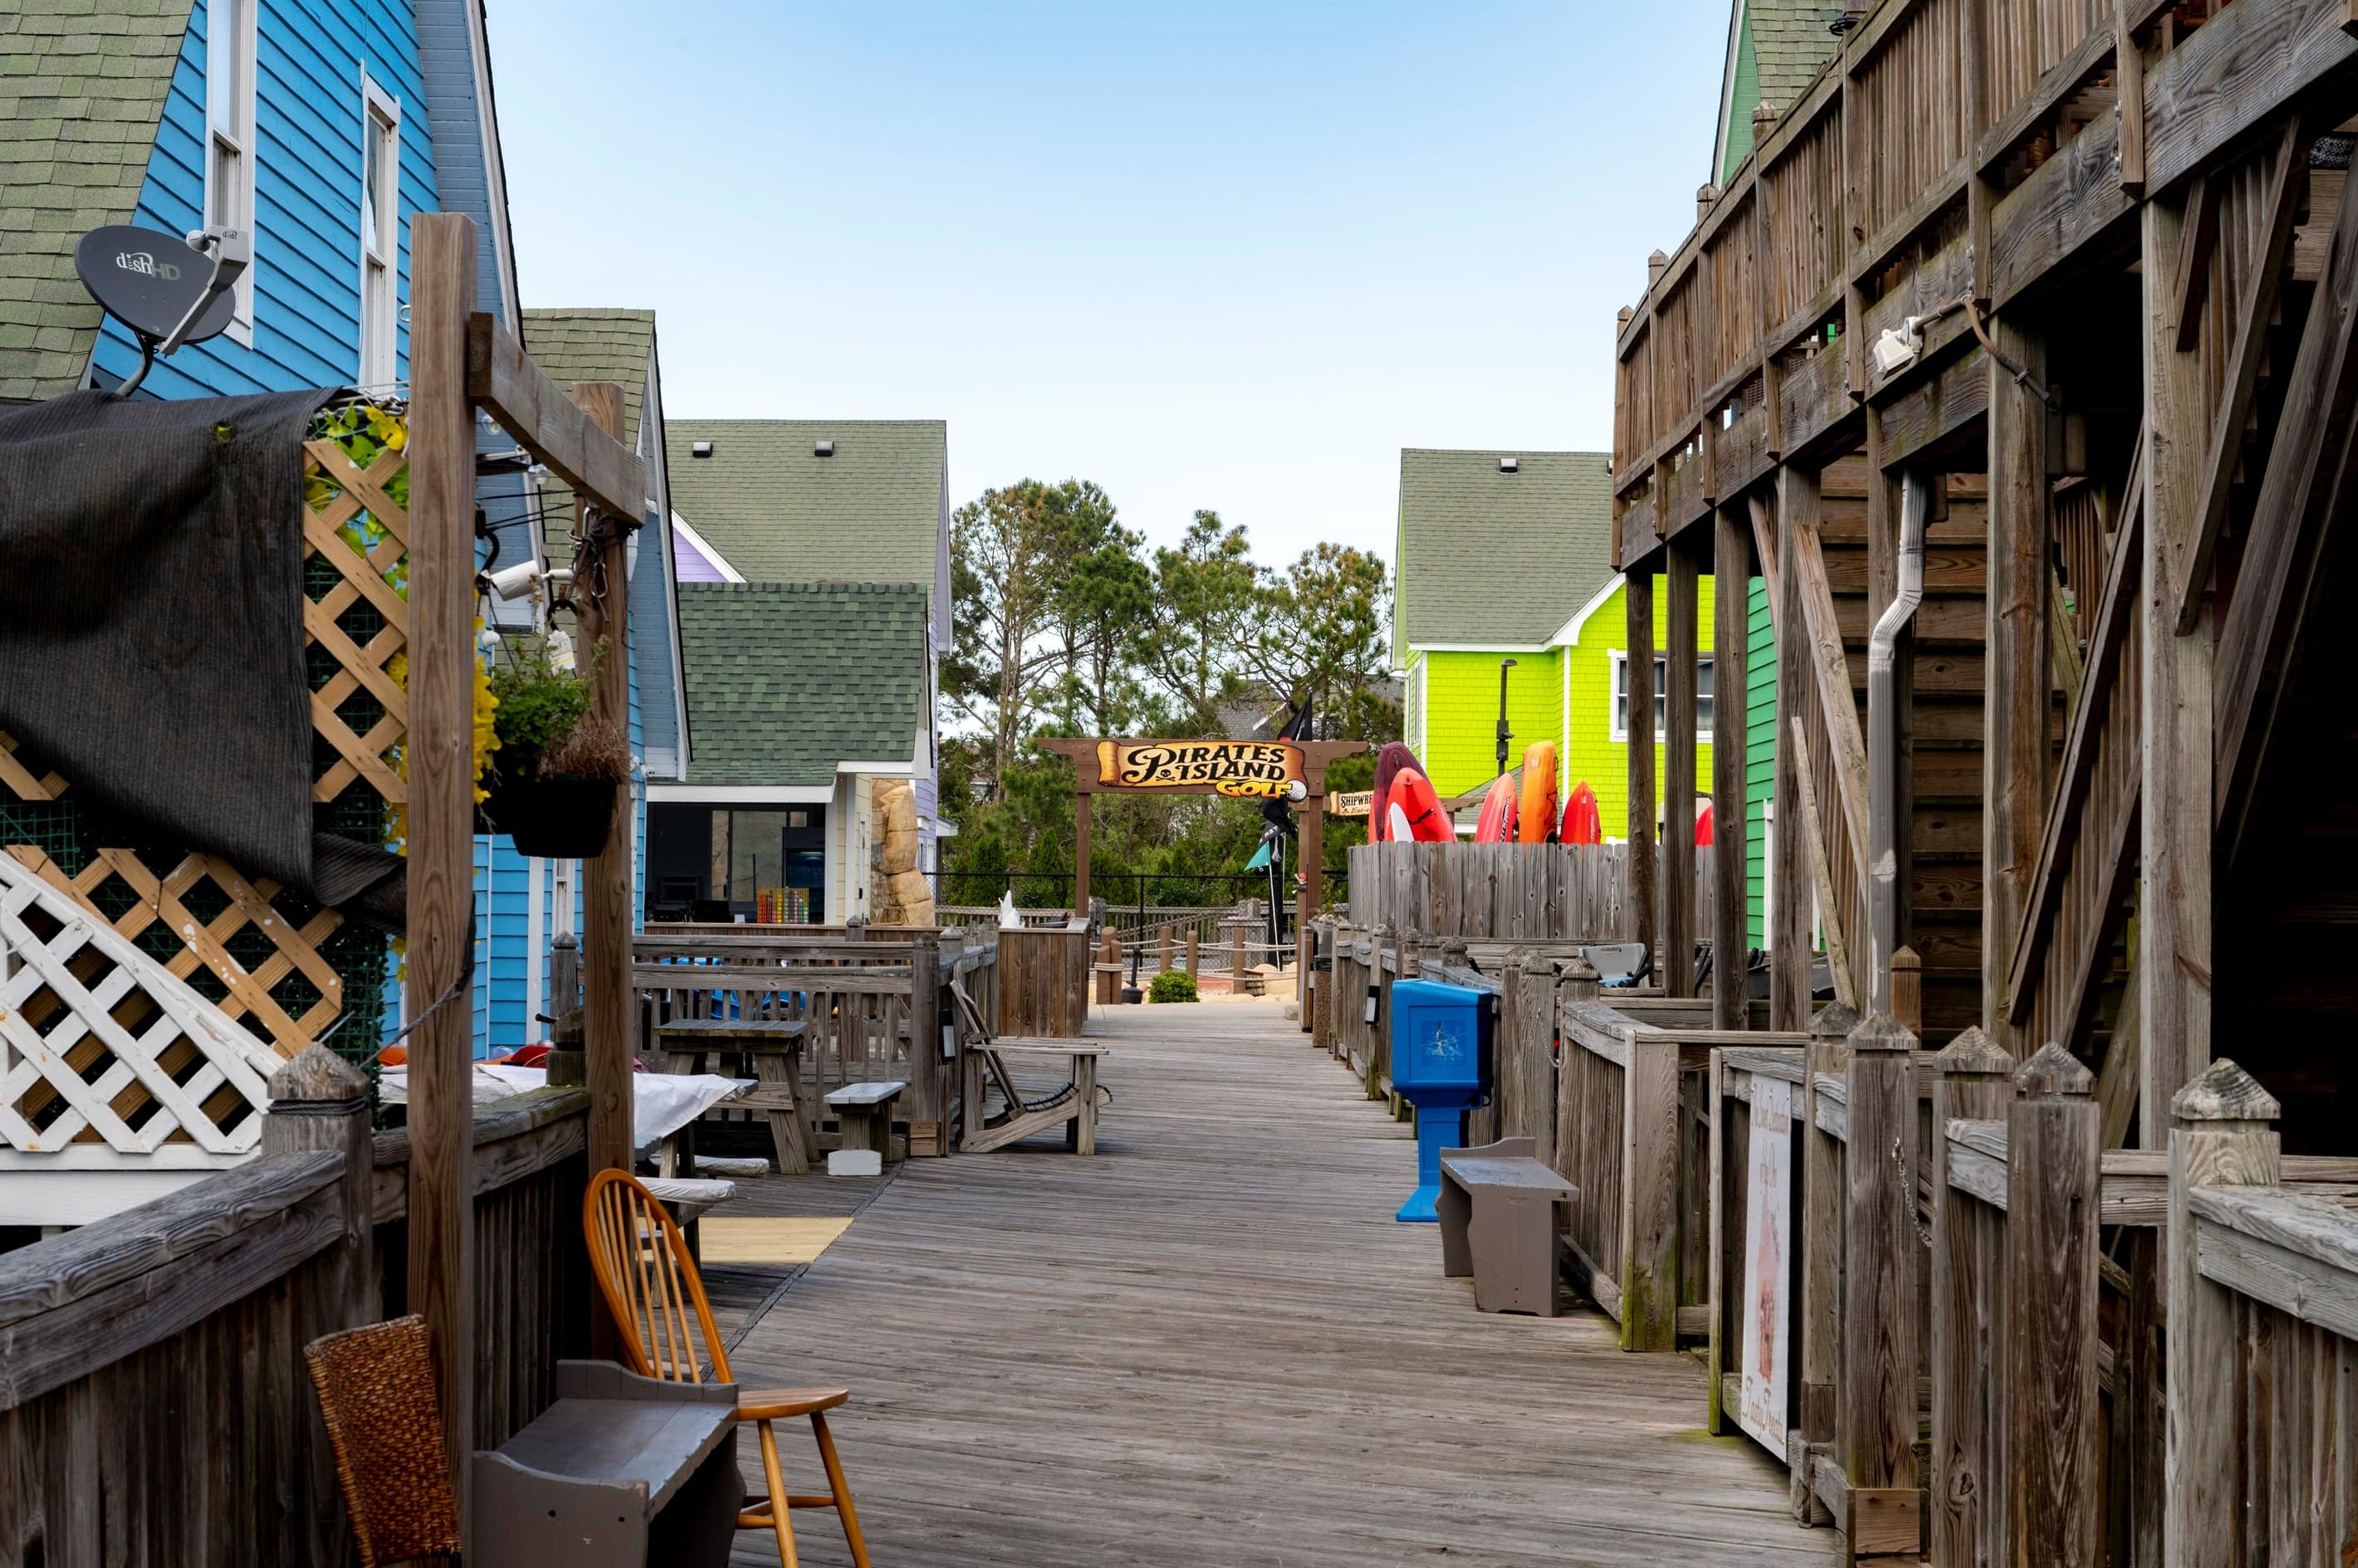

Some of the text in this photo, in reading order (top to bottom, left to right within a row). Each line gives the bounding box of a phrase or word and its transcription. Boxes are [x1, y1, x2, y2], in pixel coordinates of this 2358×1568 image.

[1121, 745, 1286, 784] PIRATES
[1175, 761, 1285, 781] ISLAND
[1216, 780, 1292, 799] GOLF
